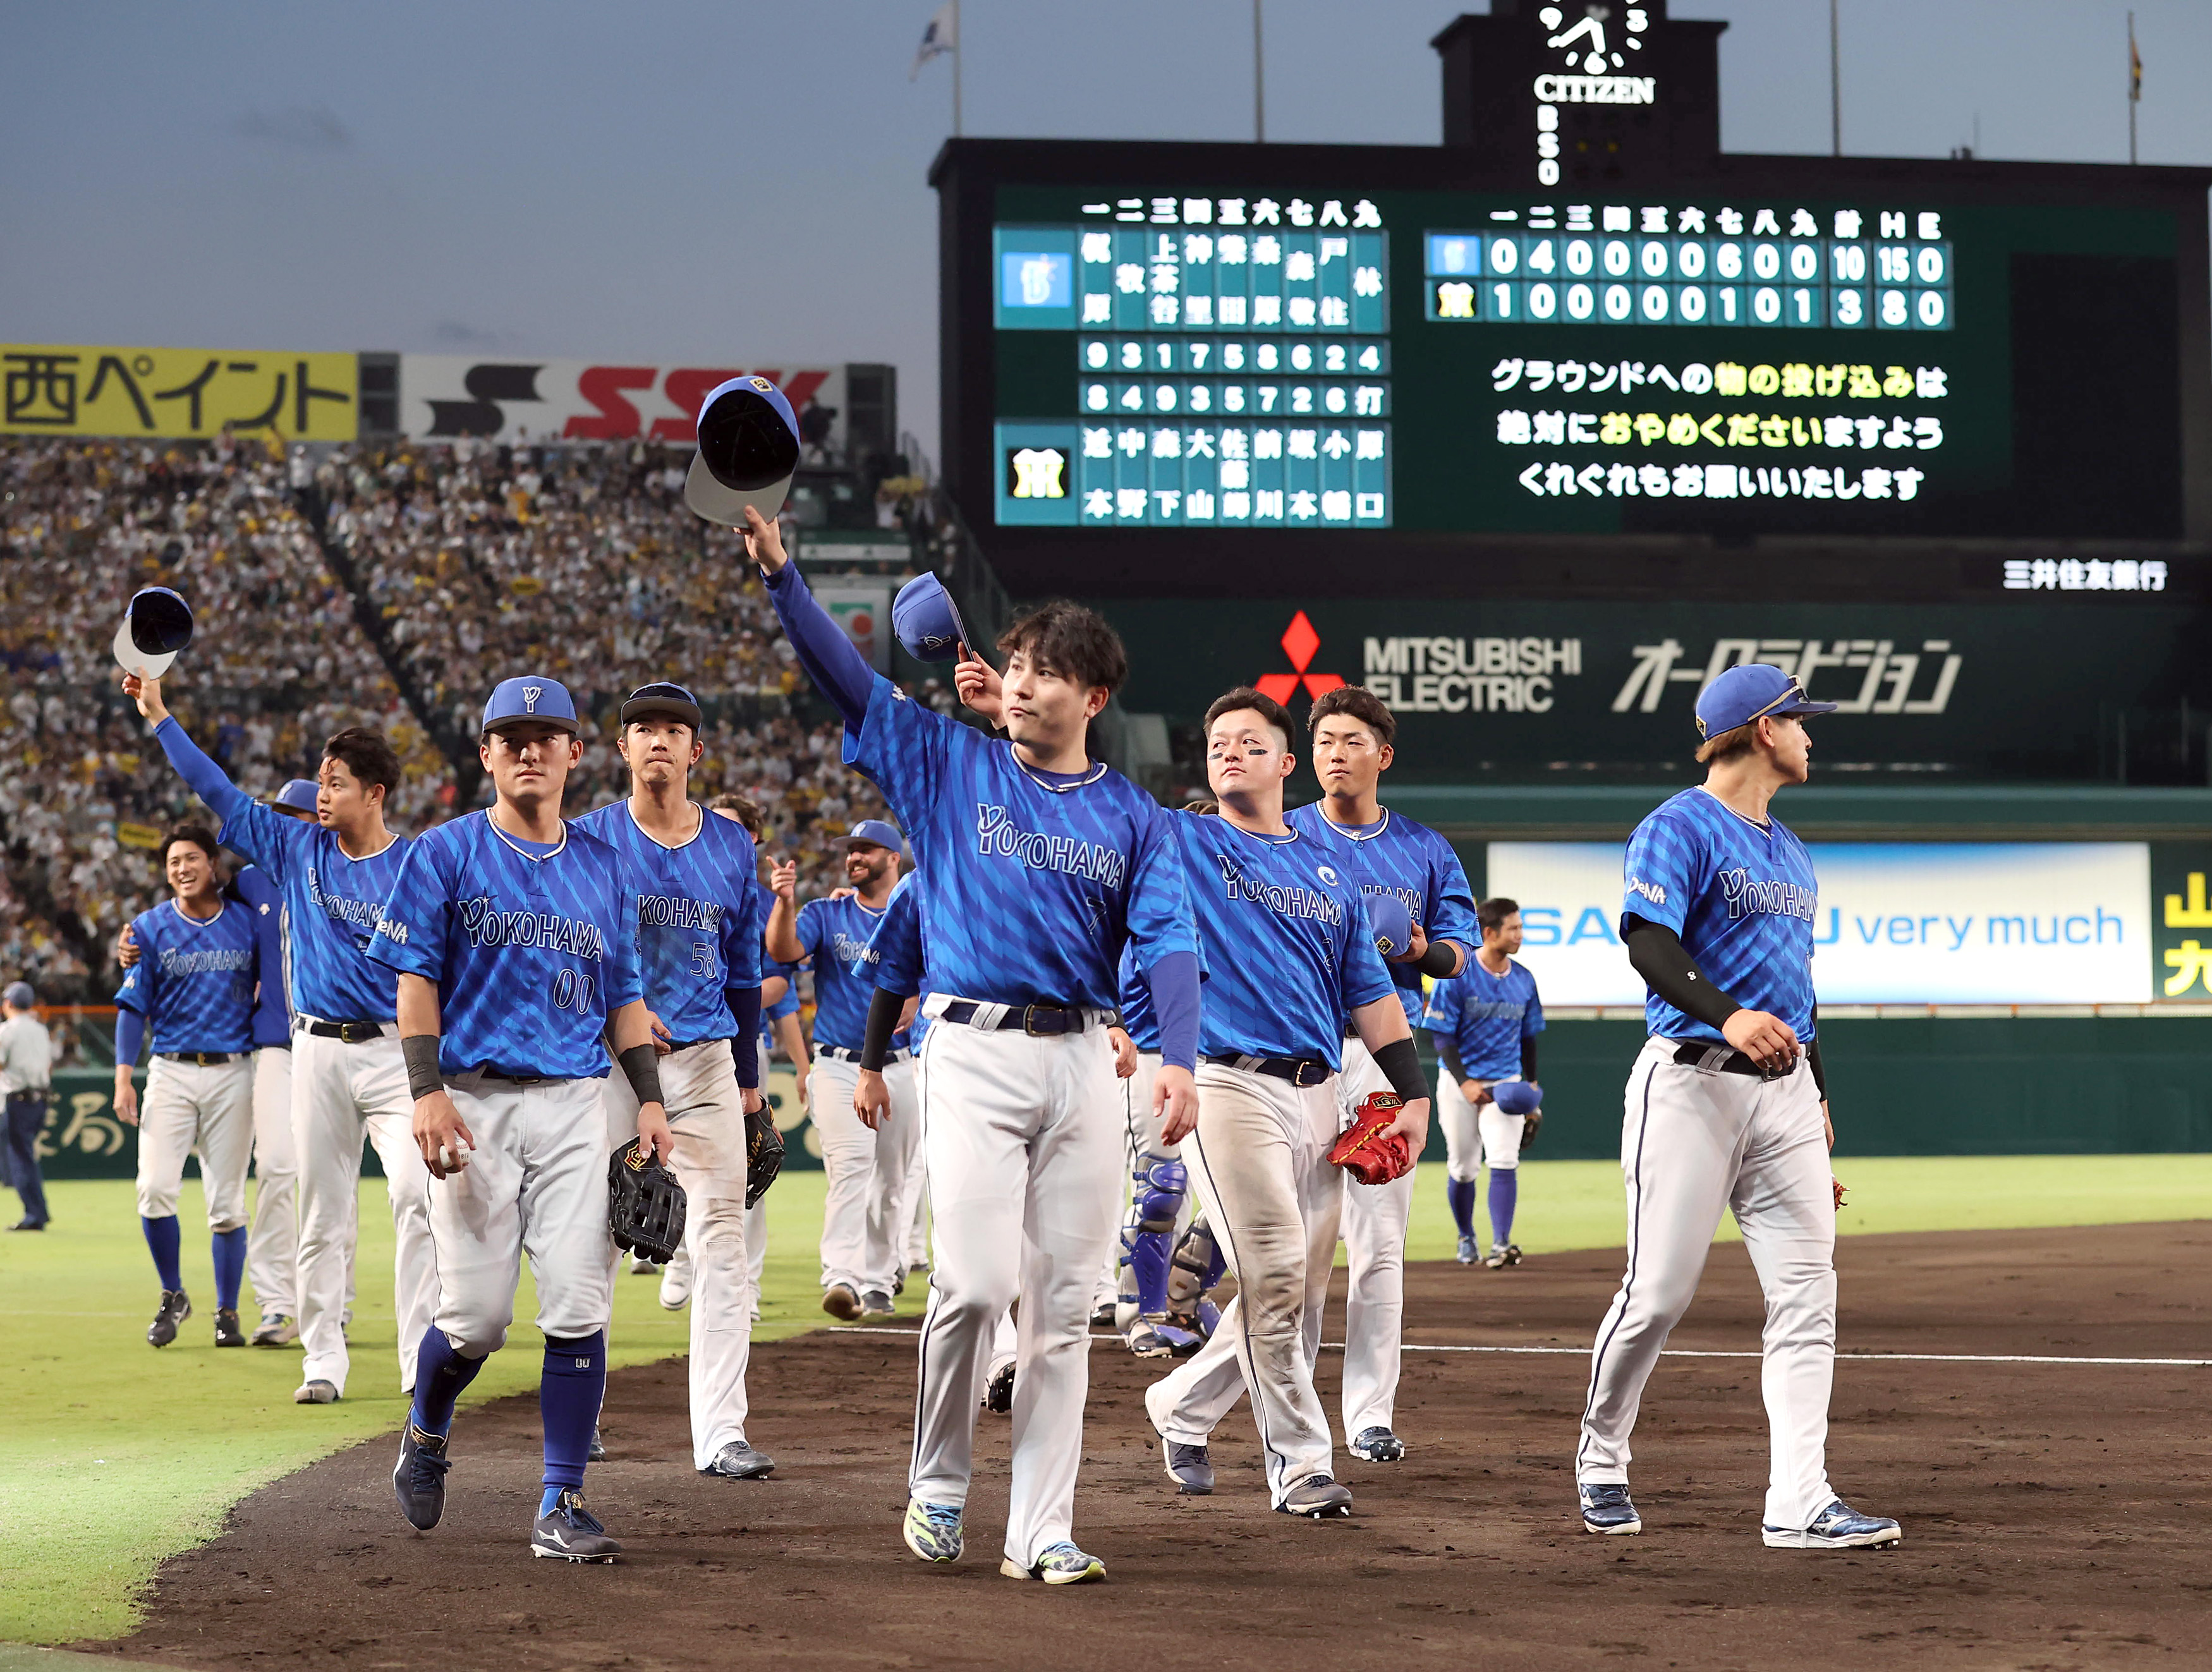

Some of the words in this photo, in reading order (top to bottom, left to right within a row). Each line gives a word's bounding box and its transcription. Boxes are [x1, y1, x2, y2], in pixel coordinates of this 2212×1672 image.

[1533, 73, 1656, 104] CITIZEN
[4, 353, 350, 433] 西ペイント
[2002, 558, 2168, 591] 三井住友銀行
[1363, 636, 1582, 674] MITSUBISHI
[1365, 674, 1554, 713] ELECTRIC
[977, 803, 1127, 892] YOKOHAMA
[1718, 868, 1818, 922] YOKOHAM
[375, 919, 409, 945] eNA
[458, 890, 603, 962] YOKOHAMA
[1856, 916, 1972, 950] very
[1988, 907, 2122, 944] much
[690, 942, 716, 979] 58
[552, 968, 595, 1015] 00
